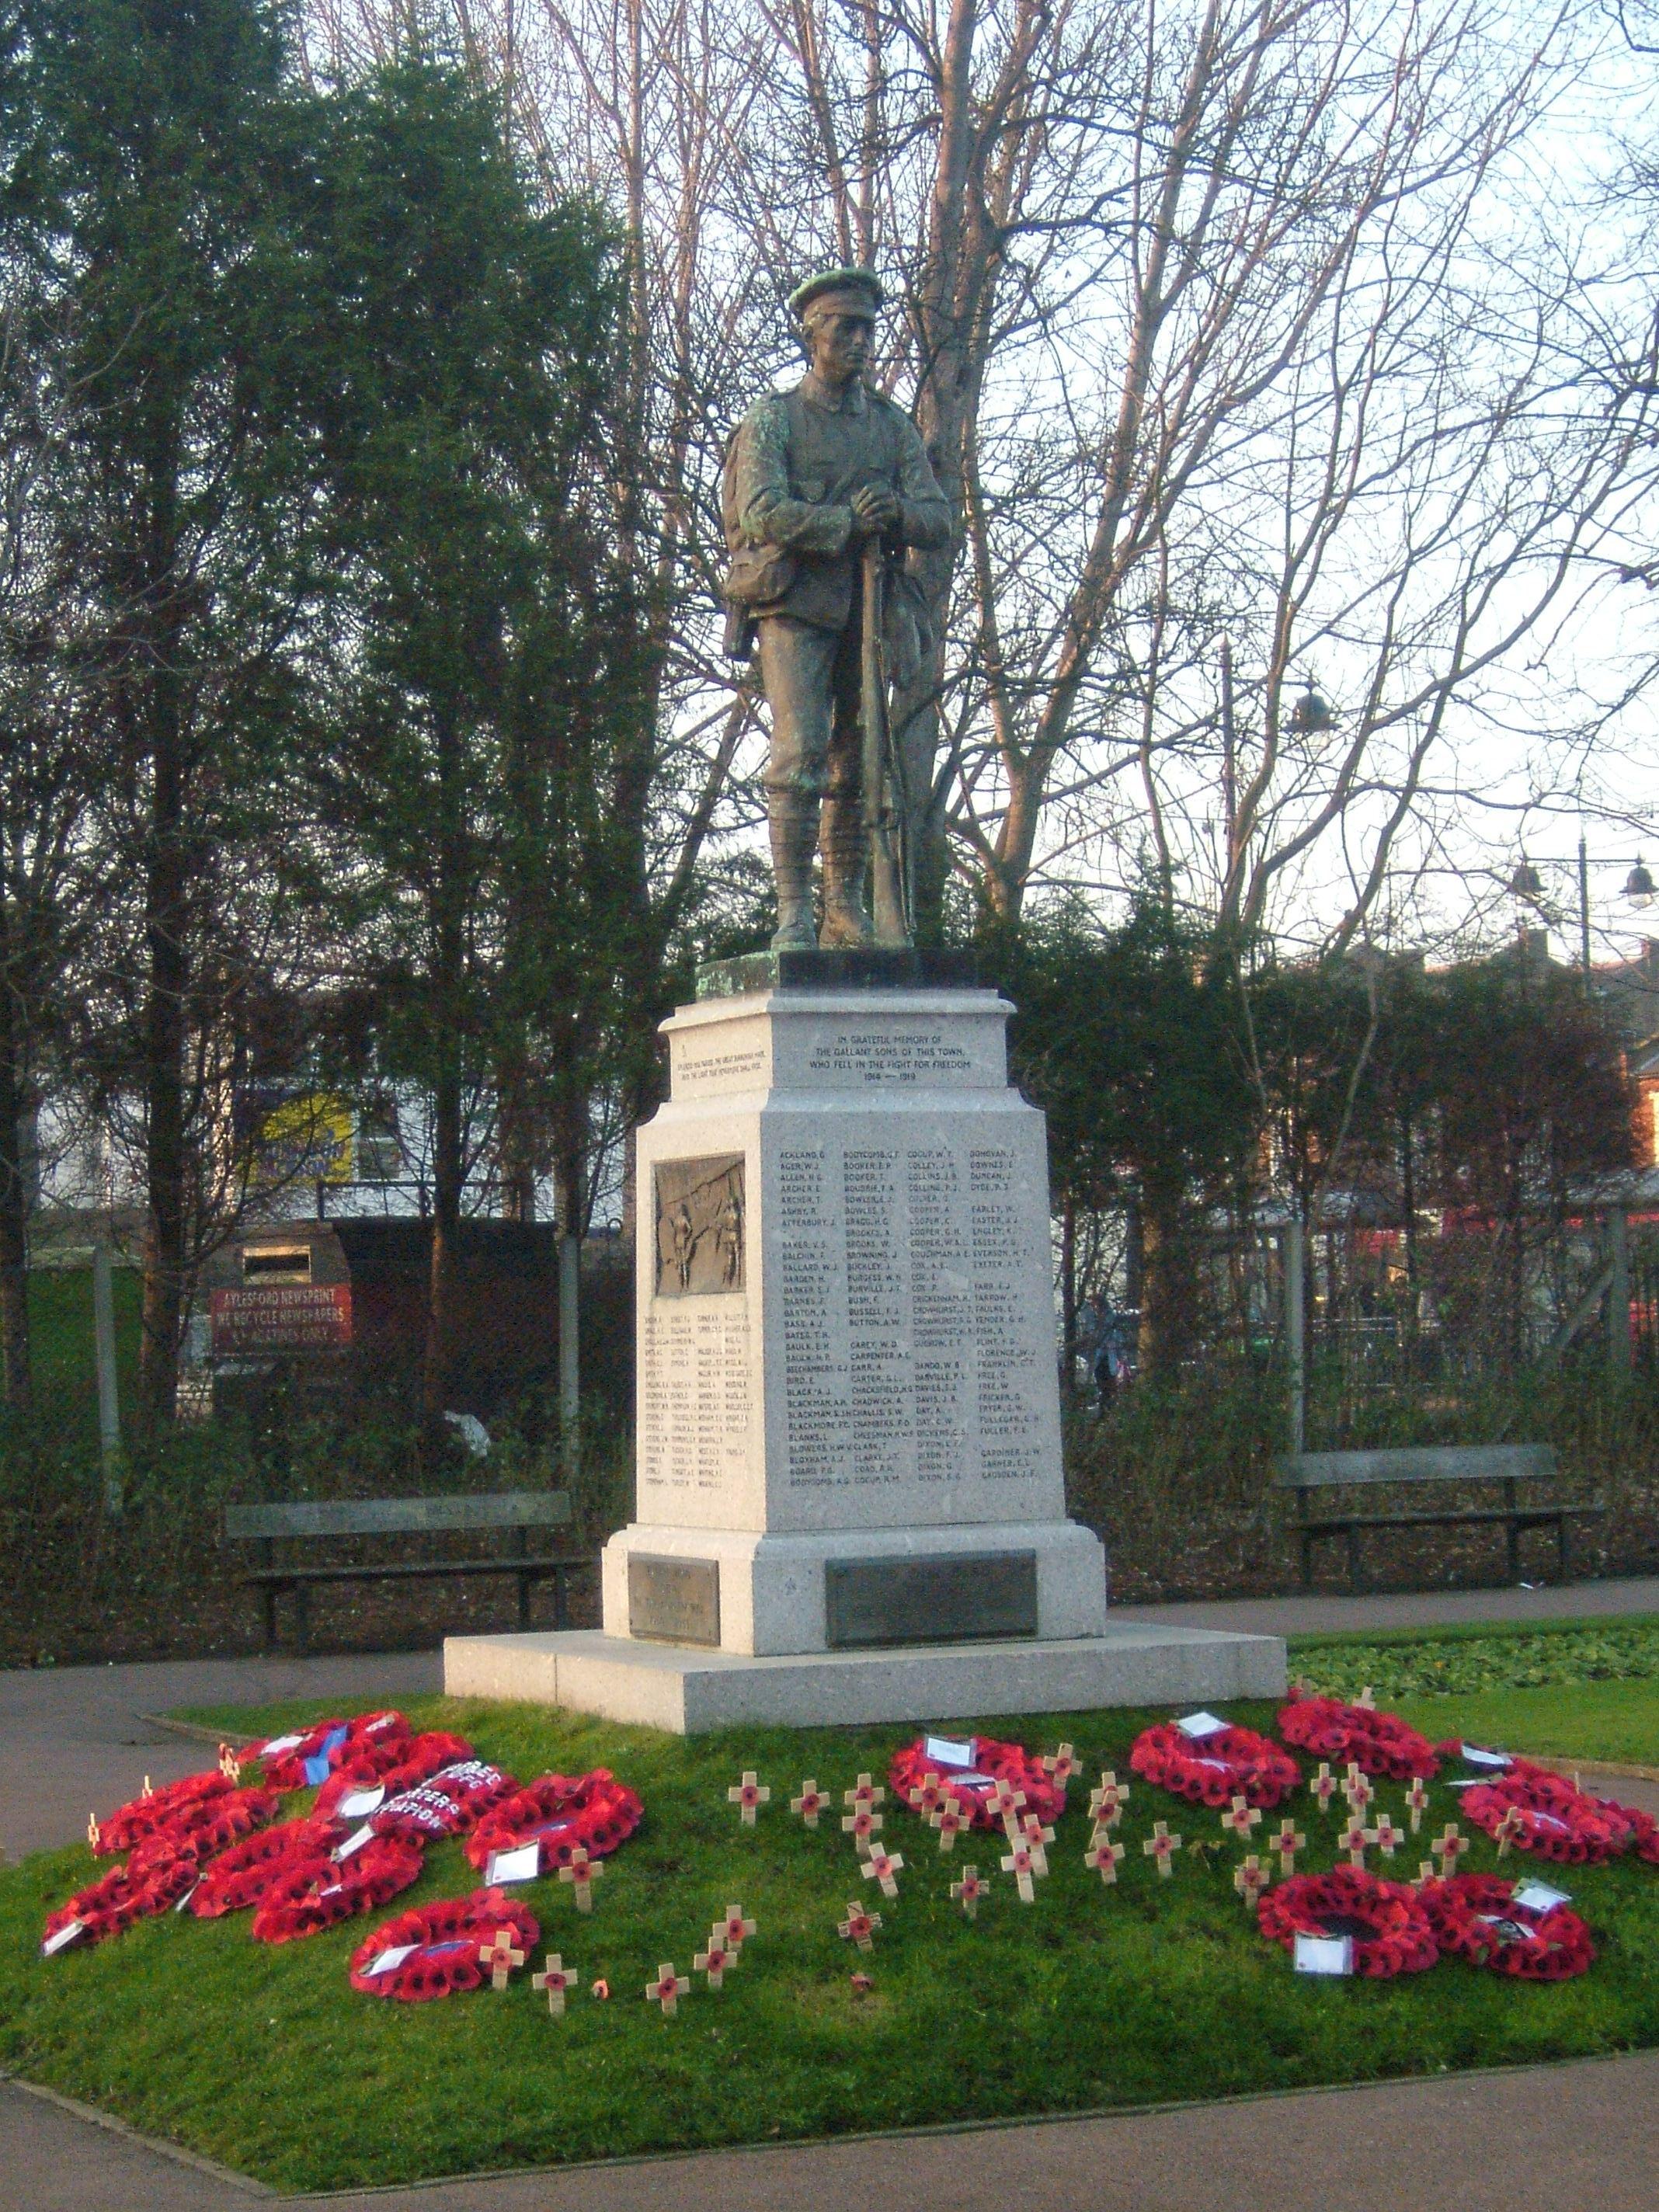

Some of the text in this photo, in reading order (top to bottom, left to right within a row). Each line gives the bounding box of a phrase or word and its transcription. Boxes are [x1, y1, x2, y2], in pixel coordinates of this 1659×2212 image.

[837, 1035, 941, 1044] IN GRATEFUL MEMORY OF
[816, 1049, 831, 1057] THE
[834, 1048, 871, 1056] GALLANT
[875, 1048, 897, 1056] SONS
[902, 1048, 912, 1056] OF
[917, 1048, 934, 1056] THIS
[834, 1060, 852, 1069] FELL
[856, 1060, 865, 1069] IN
[869, 1060, 885, 1069] THE
[888, 1060, 910, 1069] FIGHT
[914, 1060, 930, 1069] FOR
[932, 1060, 971, 1069] FREEDOM
[281, 1288, 336, 1306] NEWSPRINT
